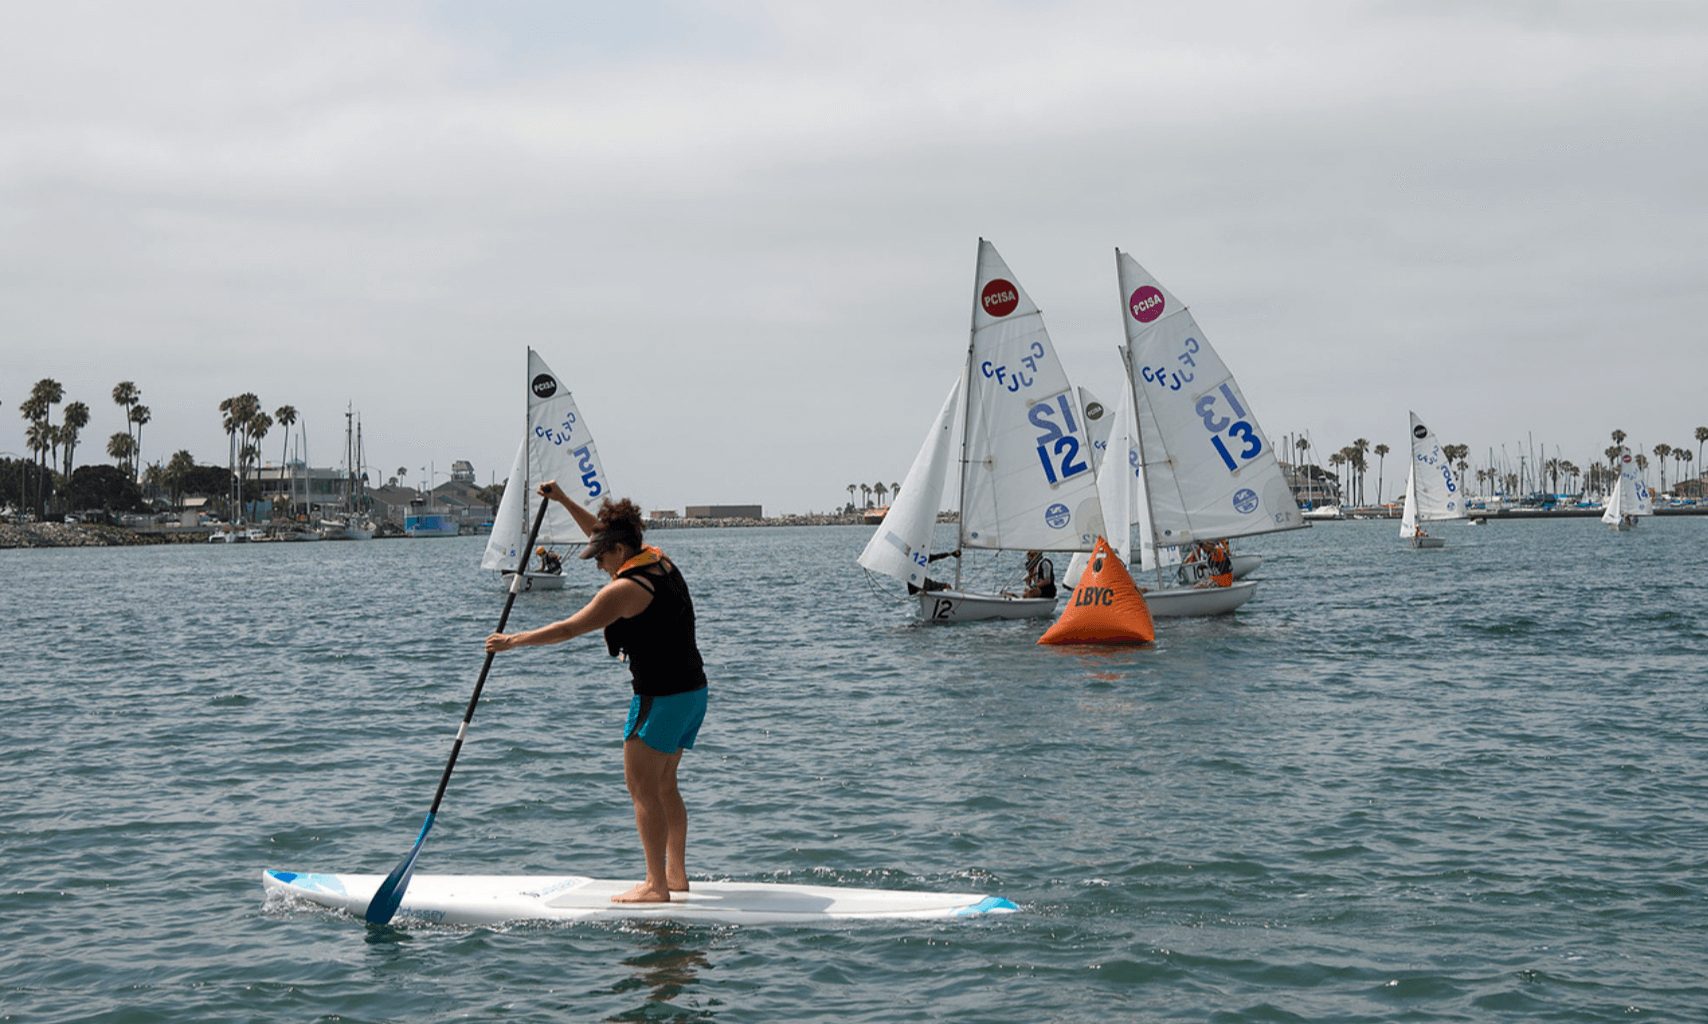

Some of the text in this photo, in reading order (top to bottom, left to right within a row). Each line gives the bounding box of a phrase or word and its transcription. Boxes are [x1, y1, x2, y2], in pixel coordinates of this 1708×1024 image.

[984, 290, 1016, 307] PCISA
[1133, 294, 1162, 316] PCISA
[981, 361, 1019, 392] CFJ
[1142, 366, 1182, 391] CFJ
[1211, 421, 1262, 472] 13
[1036, 435, 1088, 484] 12
[581, 470, 602, 497] 5
[1446, 478, 1456, 492] 6
[913, 552, 928, 567] 12
[1074, 586, 1114, 608] LBYC
[931, 599, 953, 619] 12
[399, 904, 447, 922] dyssey
